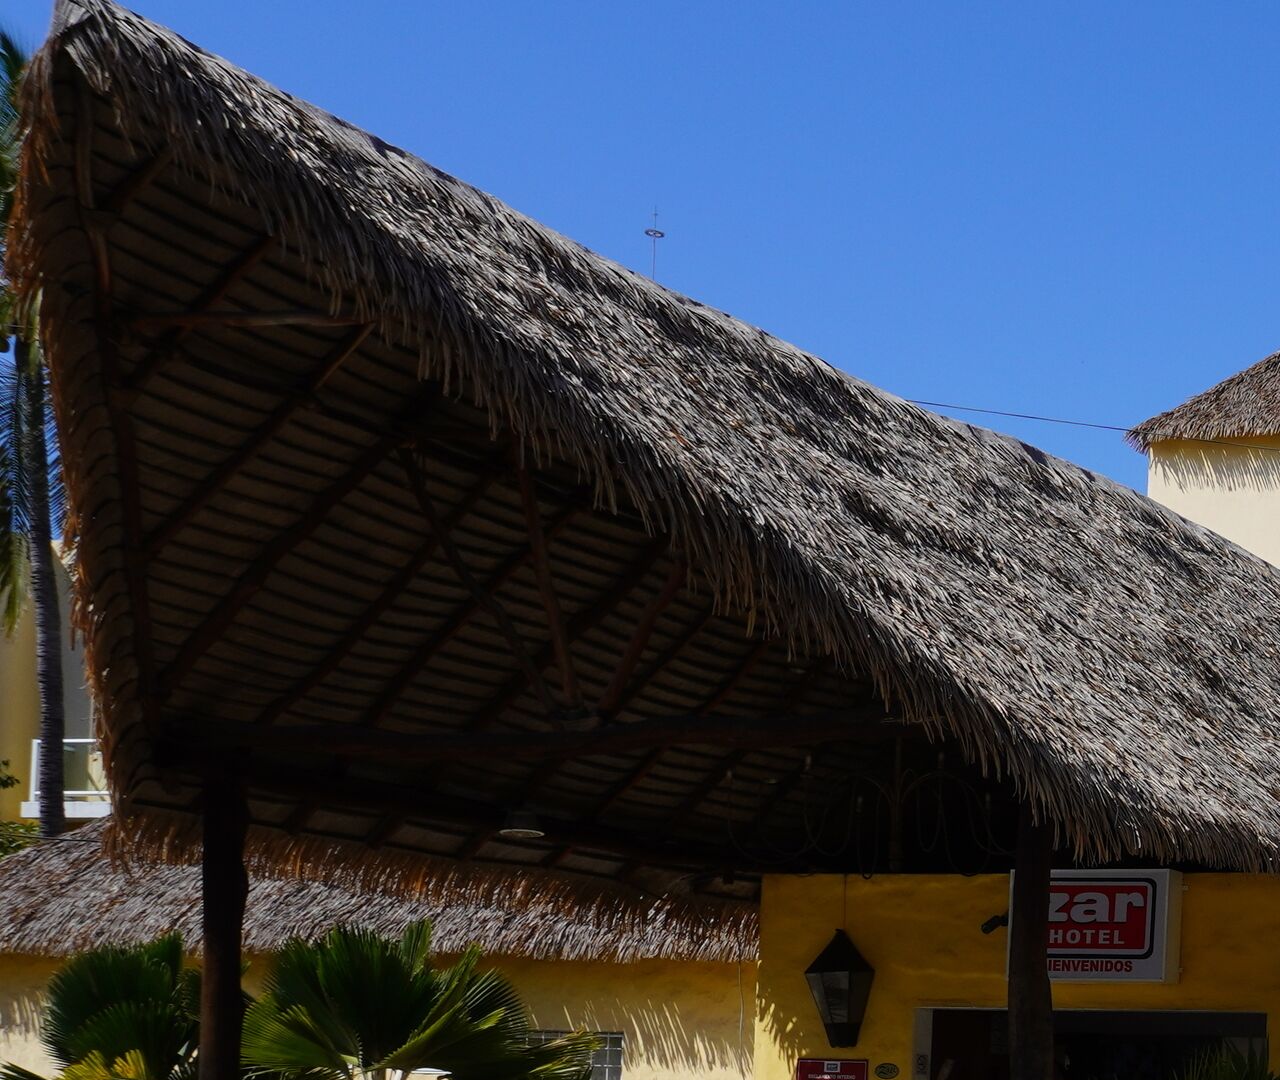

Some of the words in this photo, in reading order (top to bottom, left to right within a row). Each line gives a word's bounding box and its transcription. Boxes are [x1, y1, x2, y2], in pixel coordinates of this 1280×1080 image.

[1047, 891, 1145, 924] zar
[1049, 928, 1125, 945] HOTEL
[1047, 959, 1133, 973] IENVENIDOS
